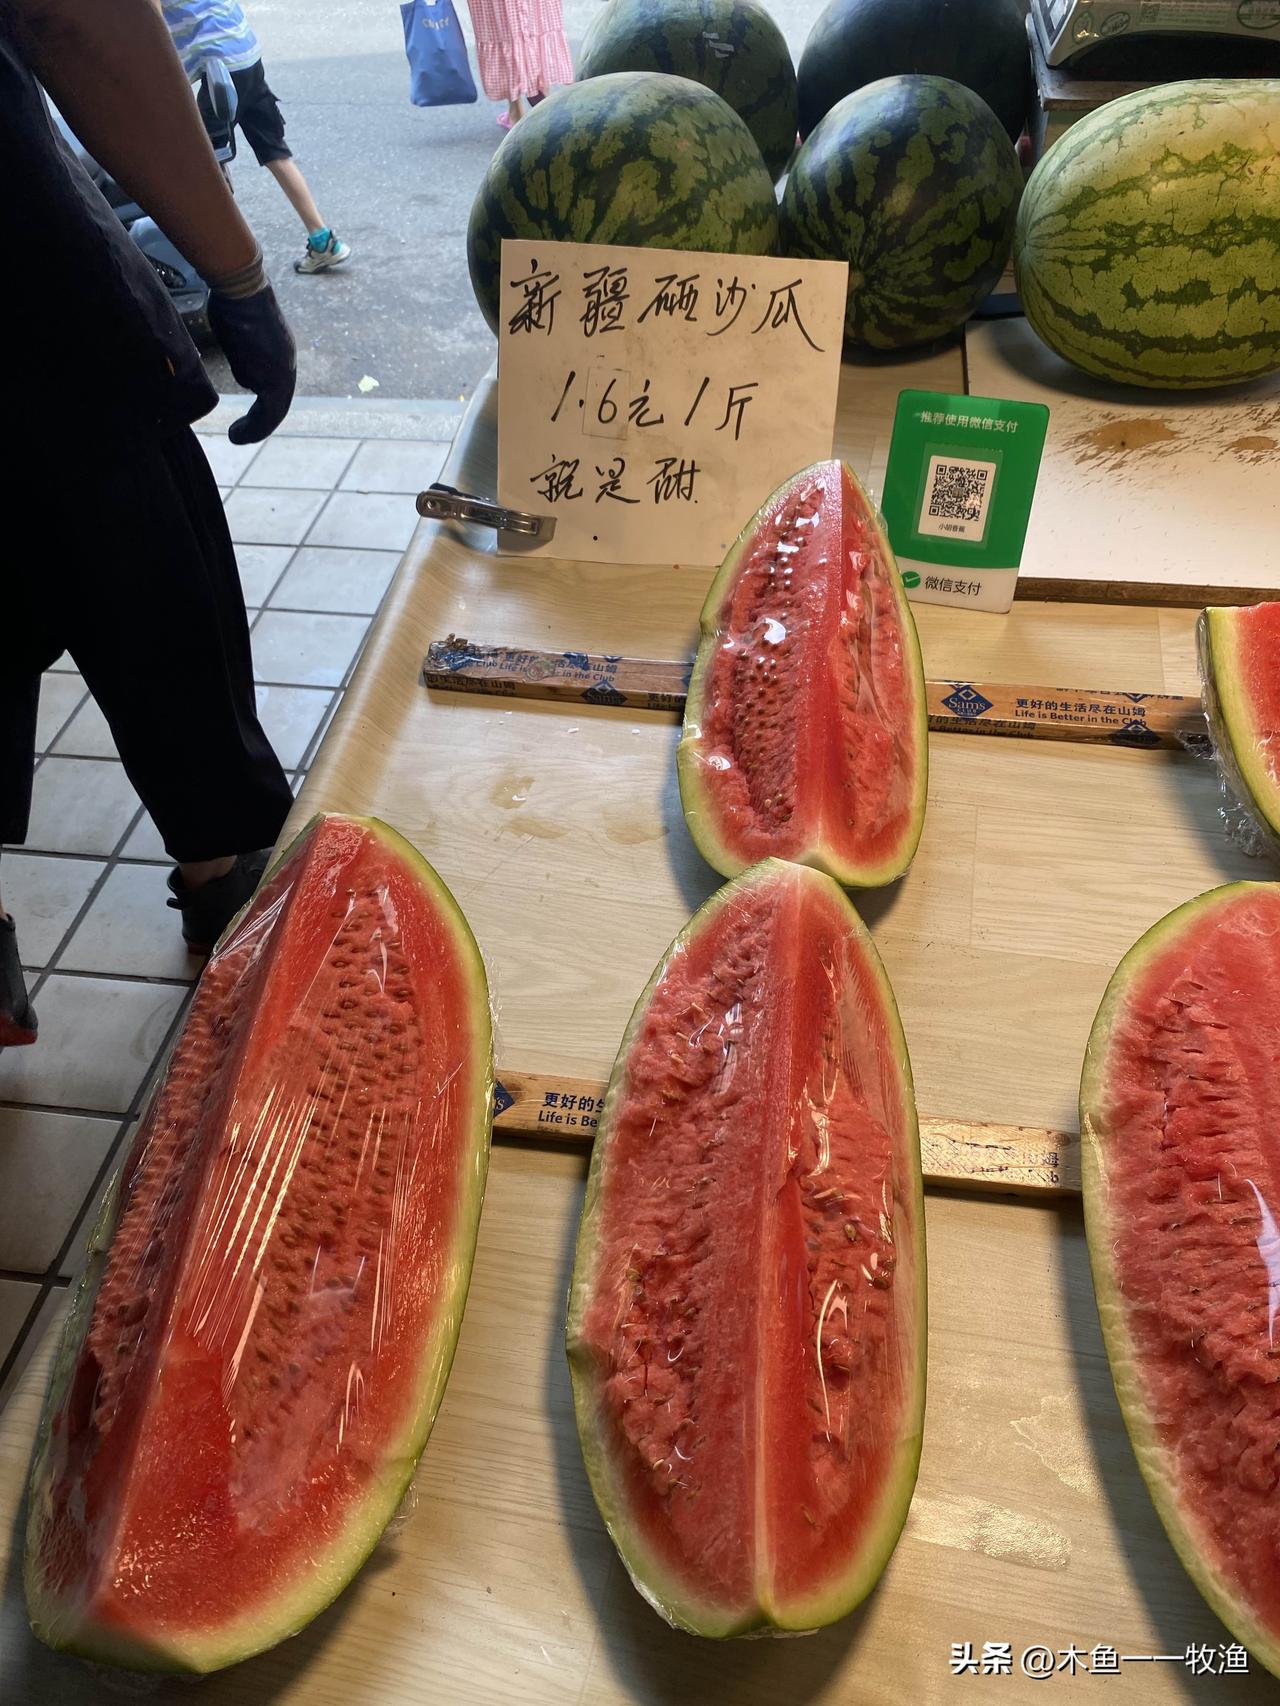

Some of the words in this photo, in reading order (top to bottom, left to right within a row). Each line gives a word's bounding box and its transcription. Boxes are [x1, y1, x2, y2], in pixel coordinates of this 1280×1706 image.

[509, 258, 825, 352] 新疆硒沙瓜
[919, 410, 1018, 433] 推荐使用微信支付
[924, 575, 982, 597] 微信支付
[1016, 698, 1146, 717] 更好的生活尽在山姆
[1015, 709, 1035, 718] Life
[1038, 711, 1047, 719] is
[1050, 712, 1084, 722] Better
[1087, 715, 1098, 723] in
[1101, 716, 1119, 725] the
[1122, 717, 1147, 727] Clb
[538, 1110, 562, 1124] Life
[566, 1113, 577, 1125] is
[581, 1115, 598, 1128] Be
